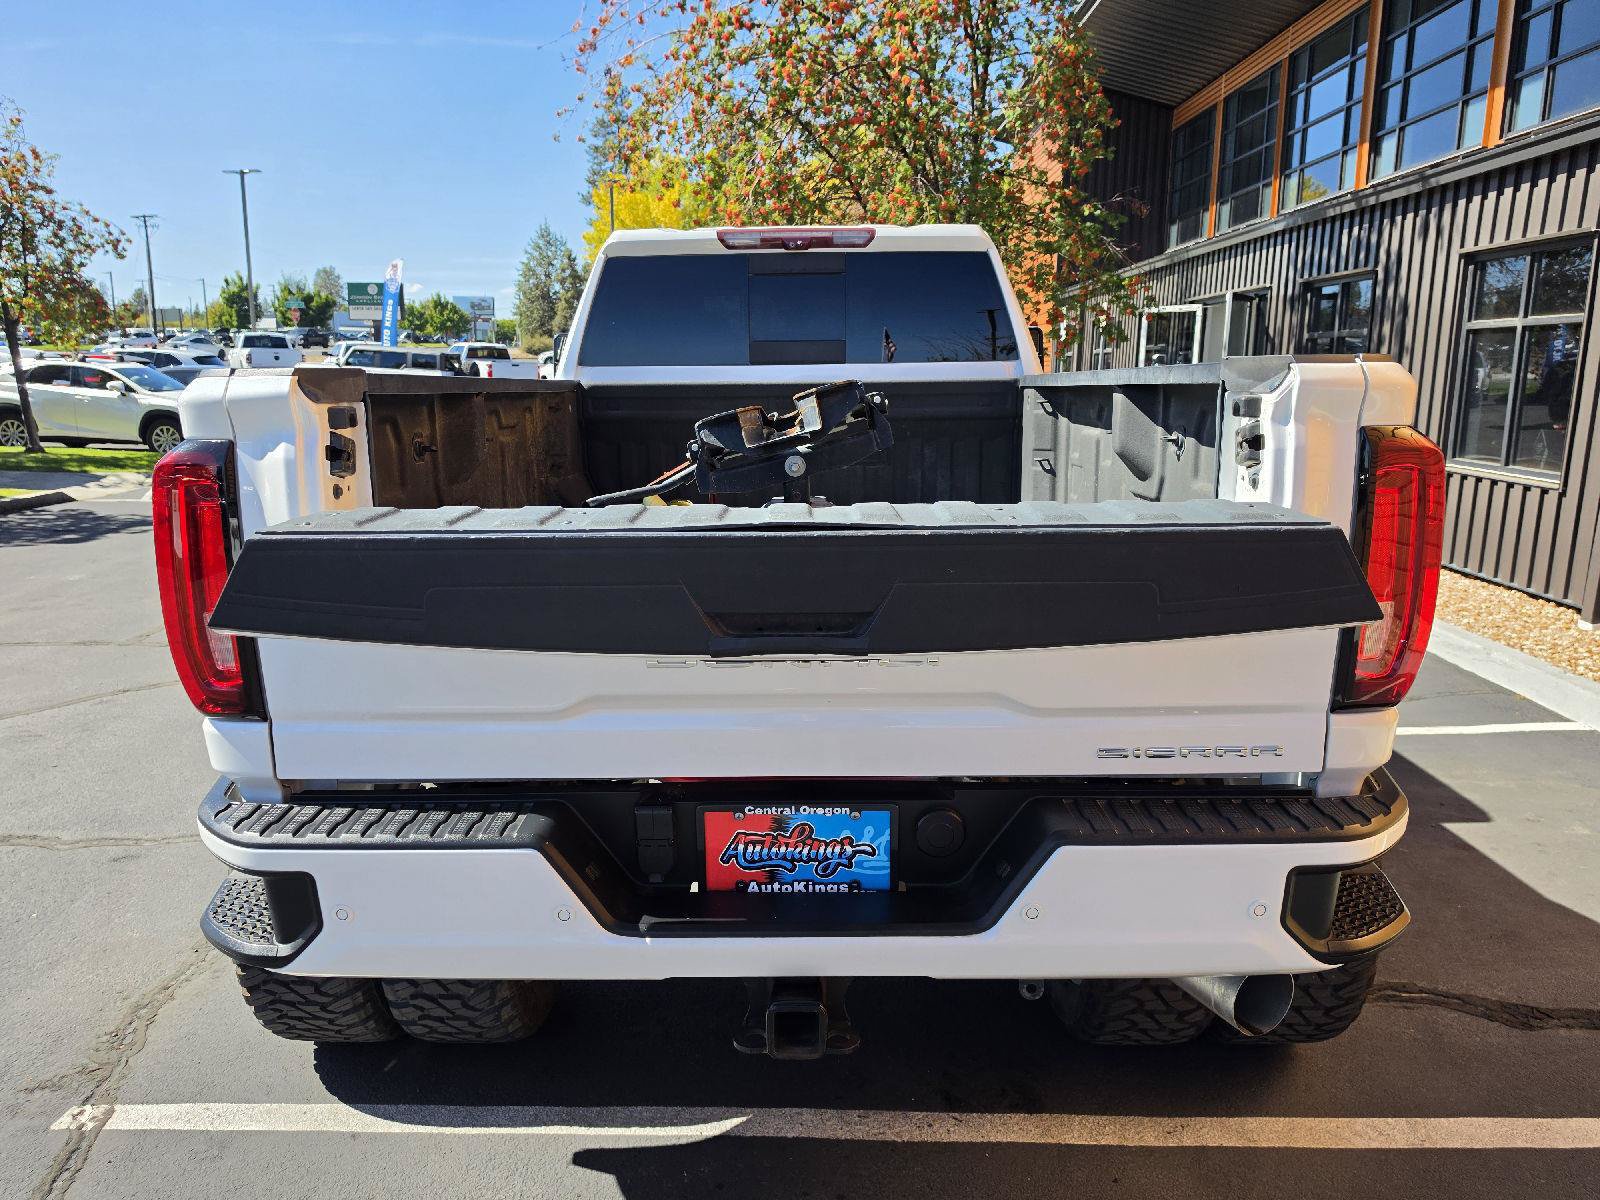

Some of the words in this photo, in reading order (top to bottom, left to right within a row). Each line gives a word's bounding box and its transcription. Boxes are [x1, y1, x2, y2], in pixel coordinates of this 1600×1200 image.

[384, 299, 394, 327] KINGS
[383, 329, 391, 347] UTO
[1097, 746, 1284, 758] SIERRA
[744, 805, 796, 815] Central
[800, 805, 850, 816] Oregon
[747, 881, 849, 893] AutoKings
